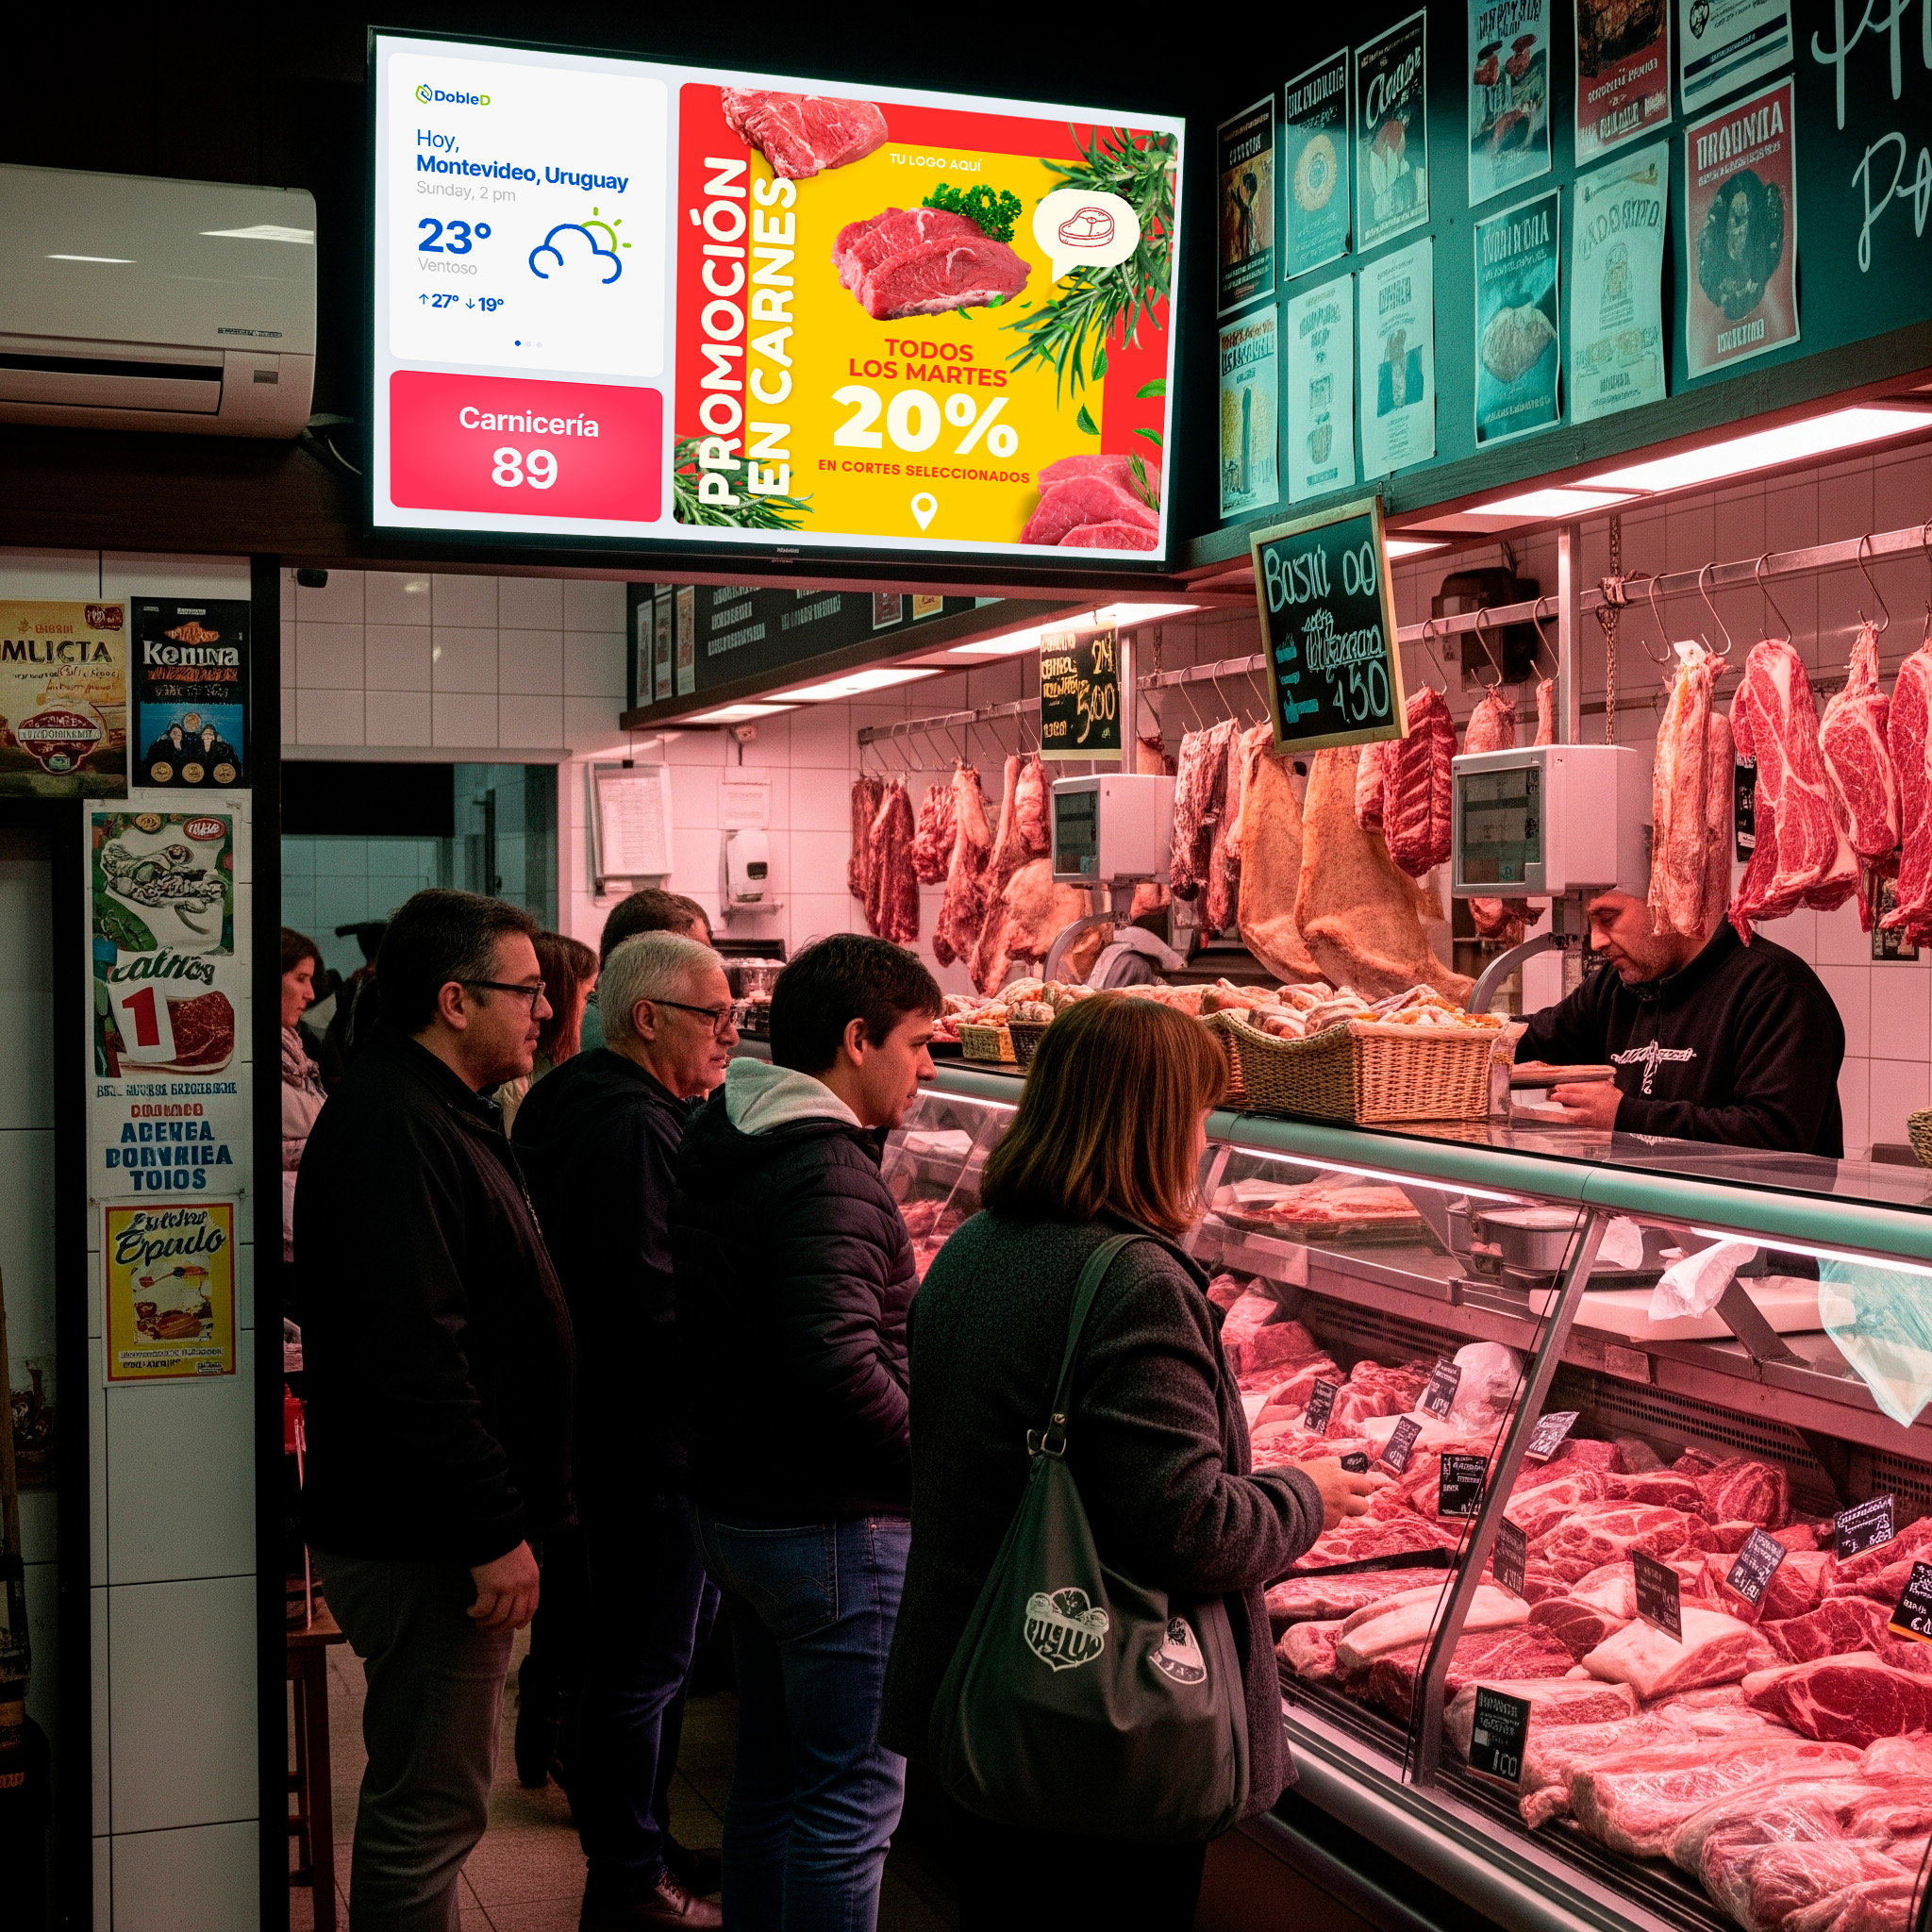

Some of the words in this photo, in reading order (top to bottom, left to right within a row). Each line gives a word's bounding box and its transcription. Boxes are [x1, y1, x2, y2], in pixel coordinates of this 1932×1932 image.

[434, 90, 491, 106] DobleD
[417, 128, 459, 153] Hoy,
[416, 154, 541, 185] Montevideo,
[544, 166, 629, 193] Uruguay
[890, 152, 906, 165] TU
[908, 154, 947, 170] LOGO
[949, 158, 981, 173] AQUÍ
[416, 180, 475, 201] Sunday,
[479, 186, 489, 200] 2
[492, 189, 516, 203] pm
[418, 258, 477, 275] Ventoso
[749, 176, 797, 406] CARNES
[690, 156, 748, 506] PROMOCIÓN
[884, 338, 974, 363] TODOS
[849, 357, 898, 381] LOS
[905, 362, 1008, 389] MARTES
[458, 406, 599, 438] Carnicería
[831, 384, 1019, 459] 20%
[491, 446, 558, 490] 89
[747, 421, 792, 496] EN
[819, 459, 837, 473] EN
[841, 460, 901, 476] CORTES
[906, 463, 1030, 484] SELECCIONADOS
[122, 986, 160, 1046] 1
